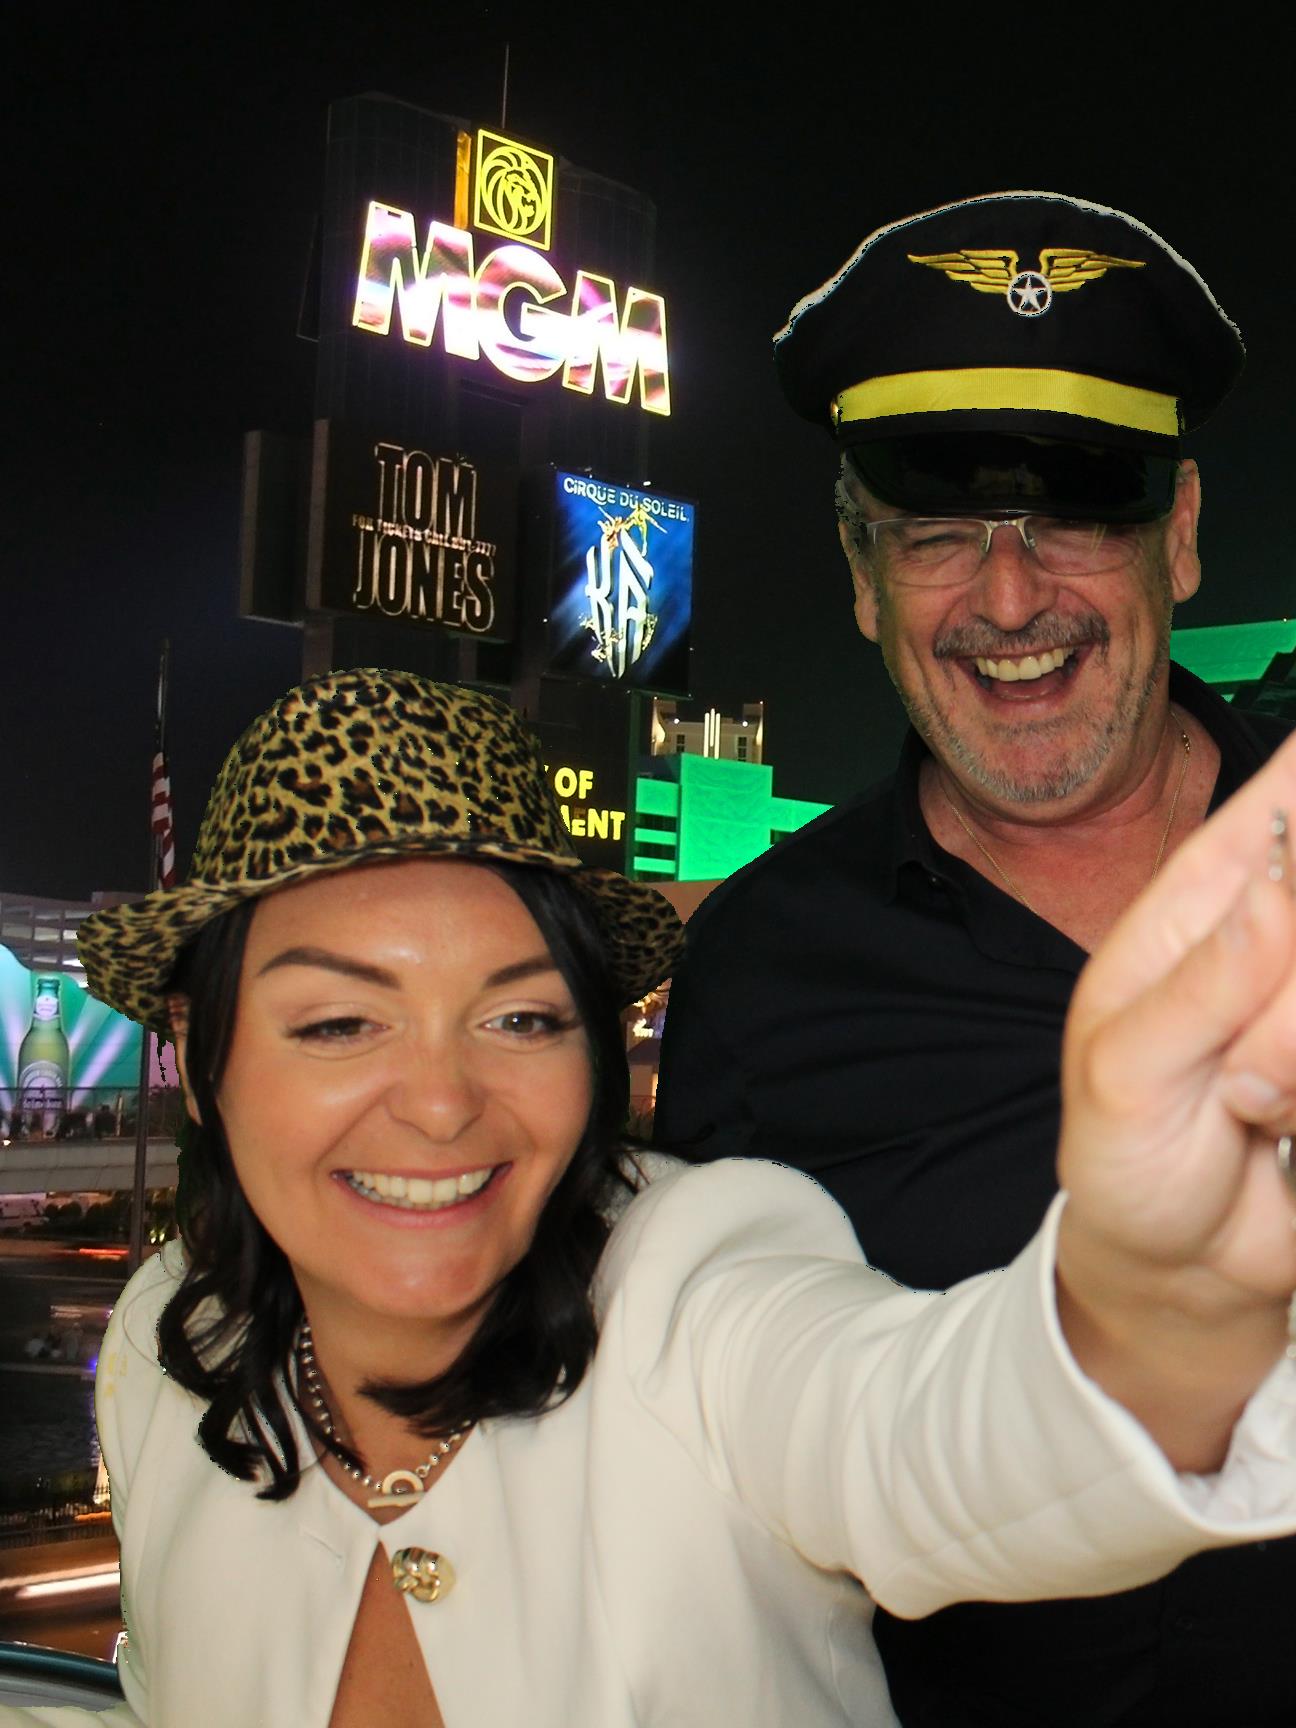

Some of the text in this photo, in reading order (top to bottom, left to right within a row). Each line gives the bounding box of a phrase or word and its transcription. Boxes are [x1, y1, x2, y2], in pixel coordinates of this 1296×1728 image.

[351, 199, 672, 417] MGM
[352, 513, 375, 531] FOR
[374, 442, 477, 540] TOM
[563, 477, 688, 522] CIRQUE DU SOLEIL
[352, 530, 496, 633] JONES
[554, 766, 594, 800] OF
